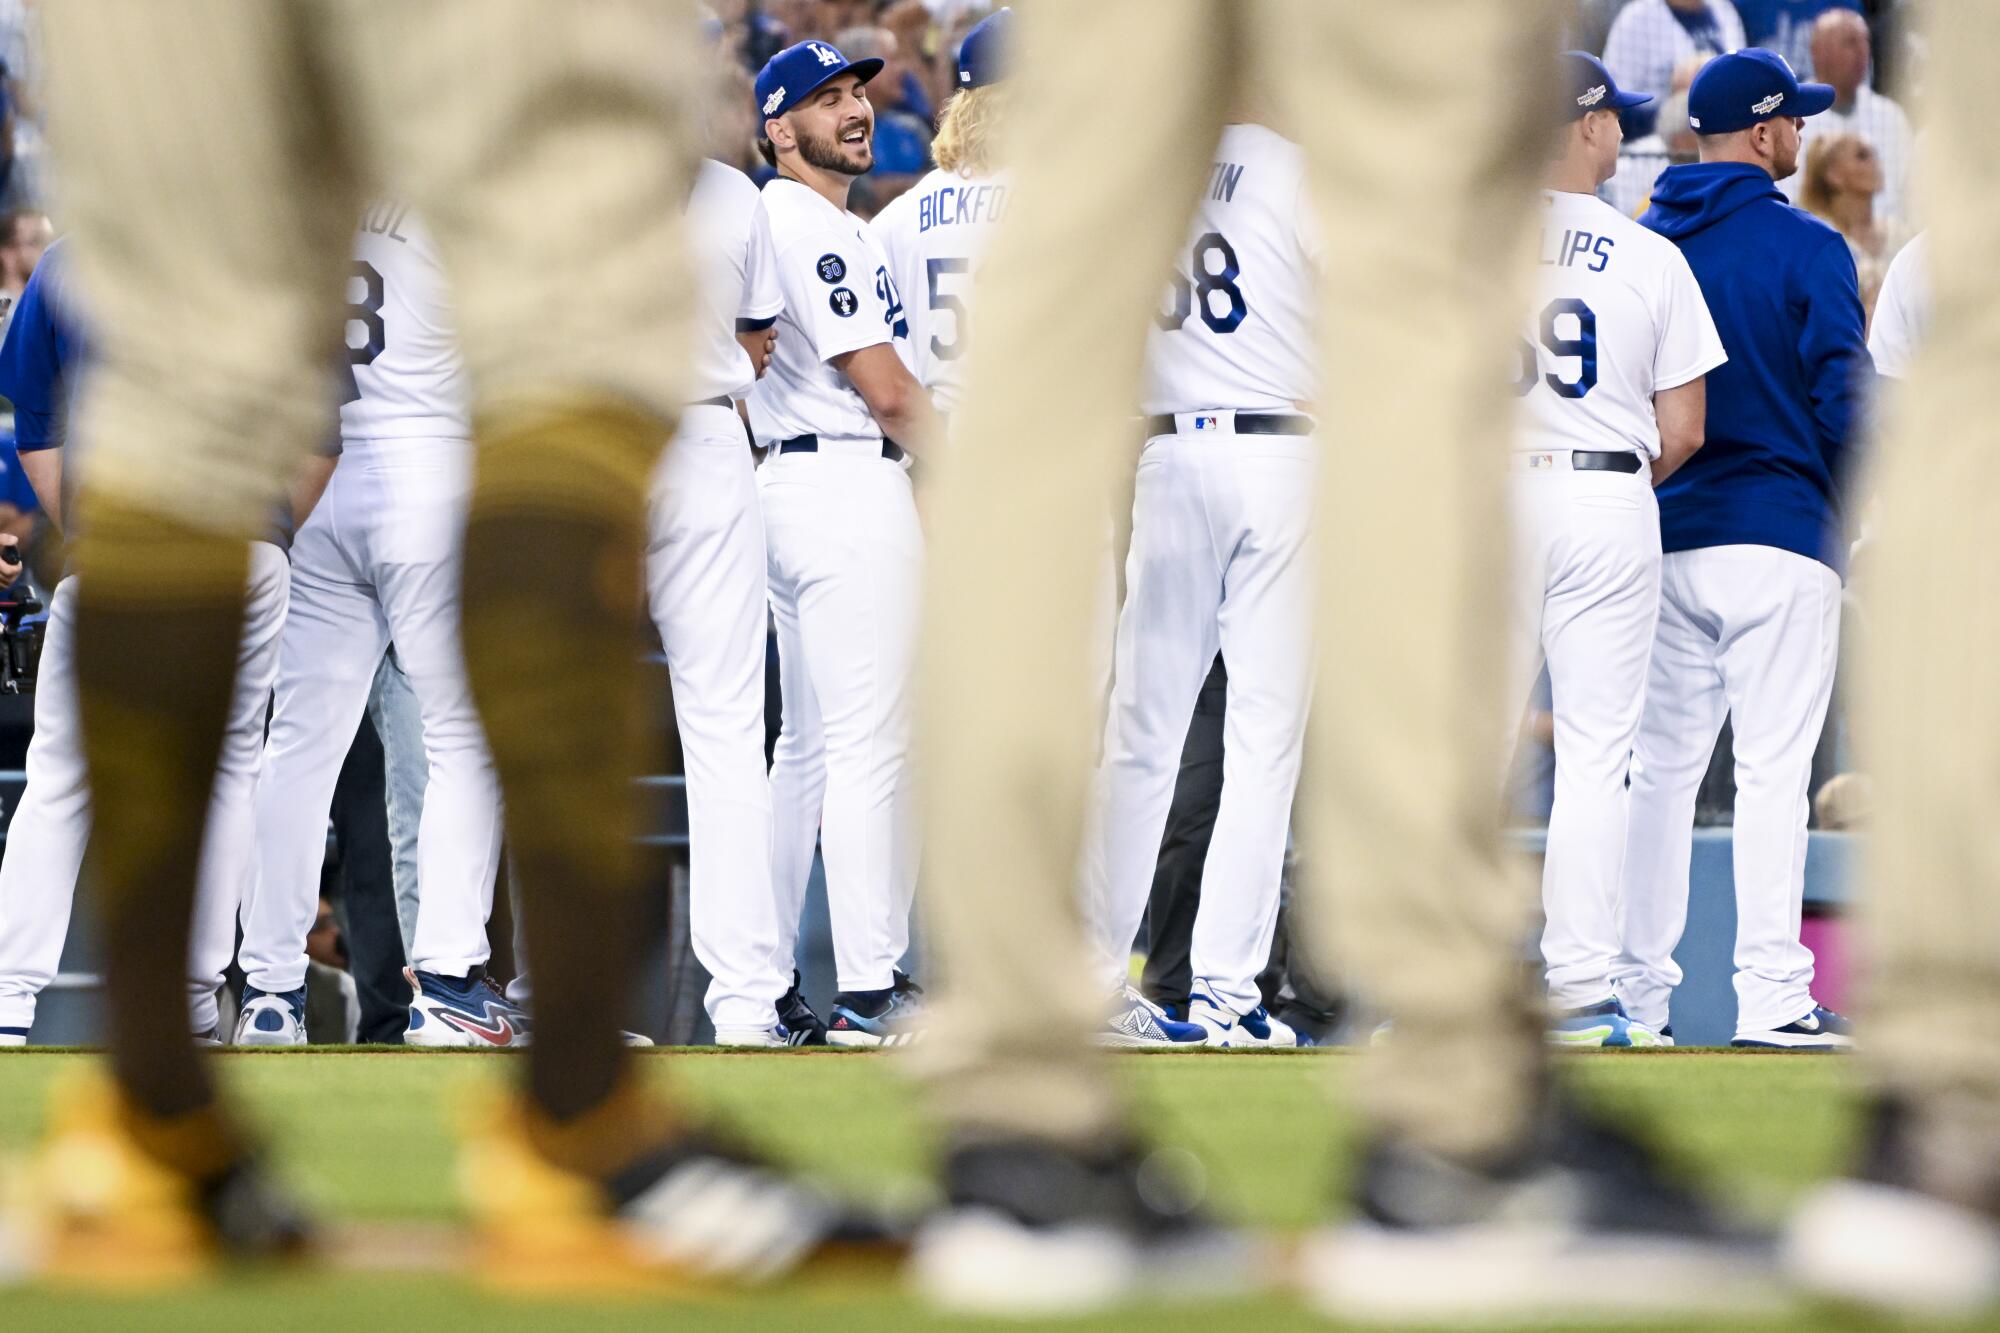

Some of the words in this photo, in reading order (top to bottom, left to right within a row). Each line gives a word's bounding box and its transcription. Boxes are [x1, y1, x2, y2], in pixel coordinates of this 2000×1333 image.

[806, 43, 841, 67] LA
[920, 185, 1013, 234] BICKFO
[1539, 228, 1615, 273] LIPS
[822, 262, 843, 280] 30
[833, 290, 851, 303] VIN
[926, 257, 970, 361] 5
